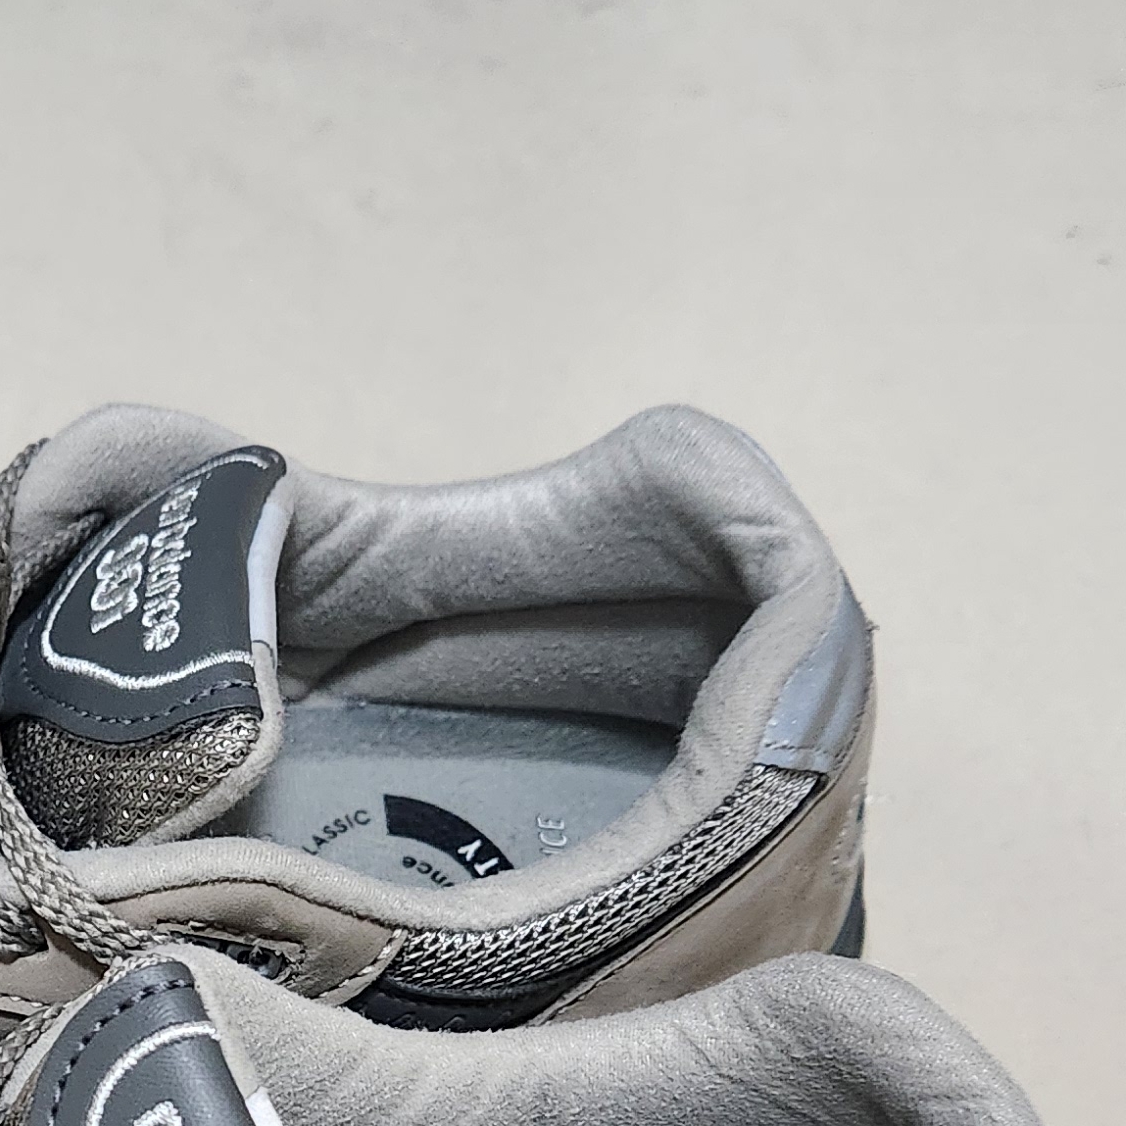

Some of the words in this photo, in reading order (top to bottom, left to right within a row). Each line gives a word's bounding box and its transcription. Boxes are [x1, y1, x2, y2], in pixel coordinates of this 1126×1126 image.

[90, 533, 149, 634] 991
[141, 516, 198, 652] balance
[402, 856, 454, 888] nce
